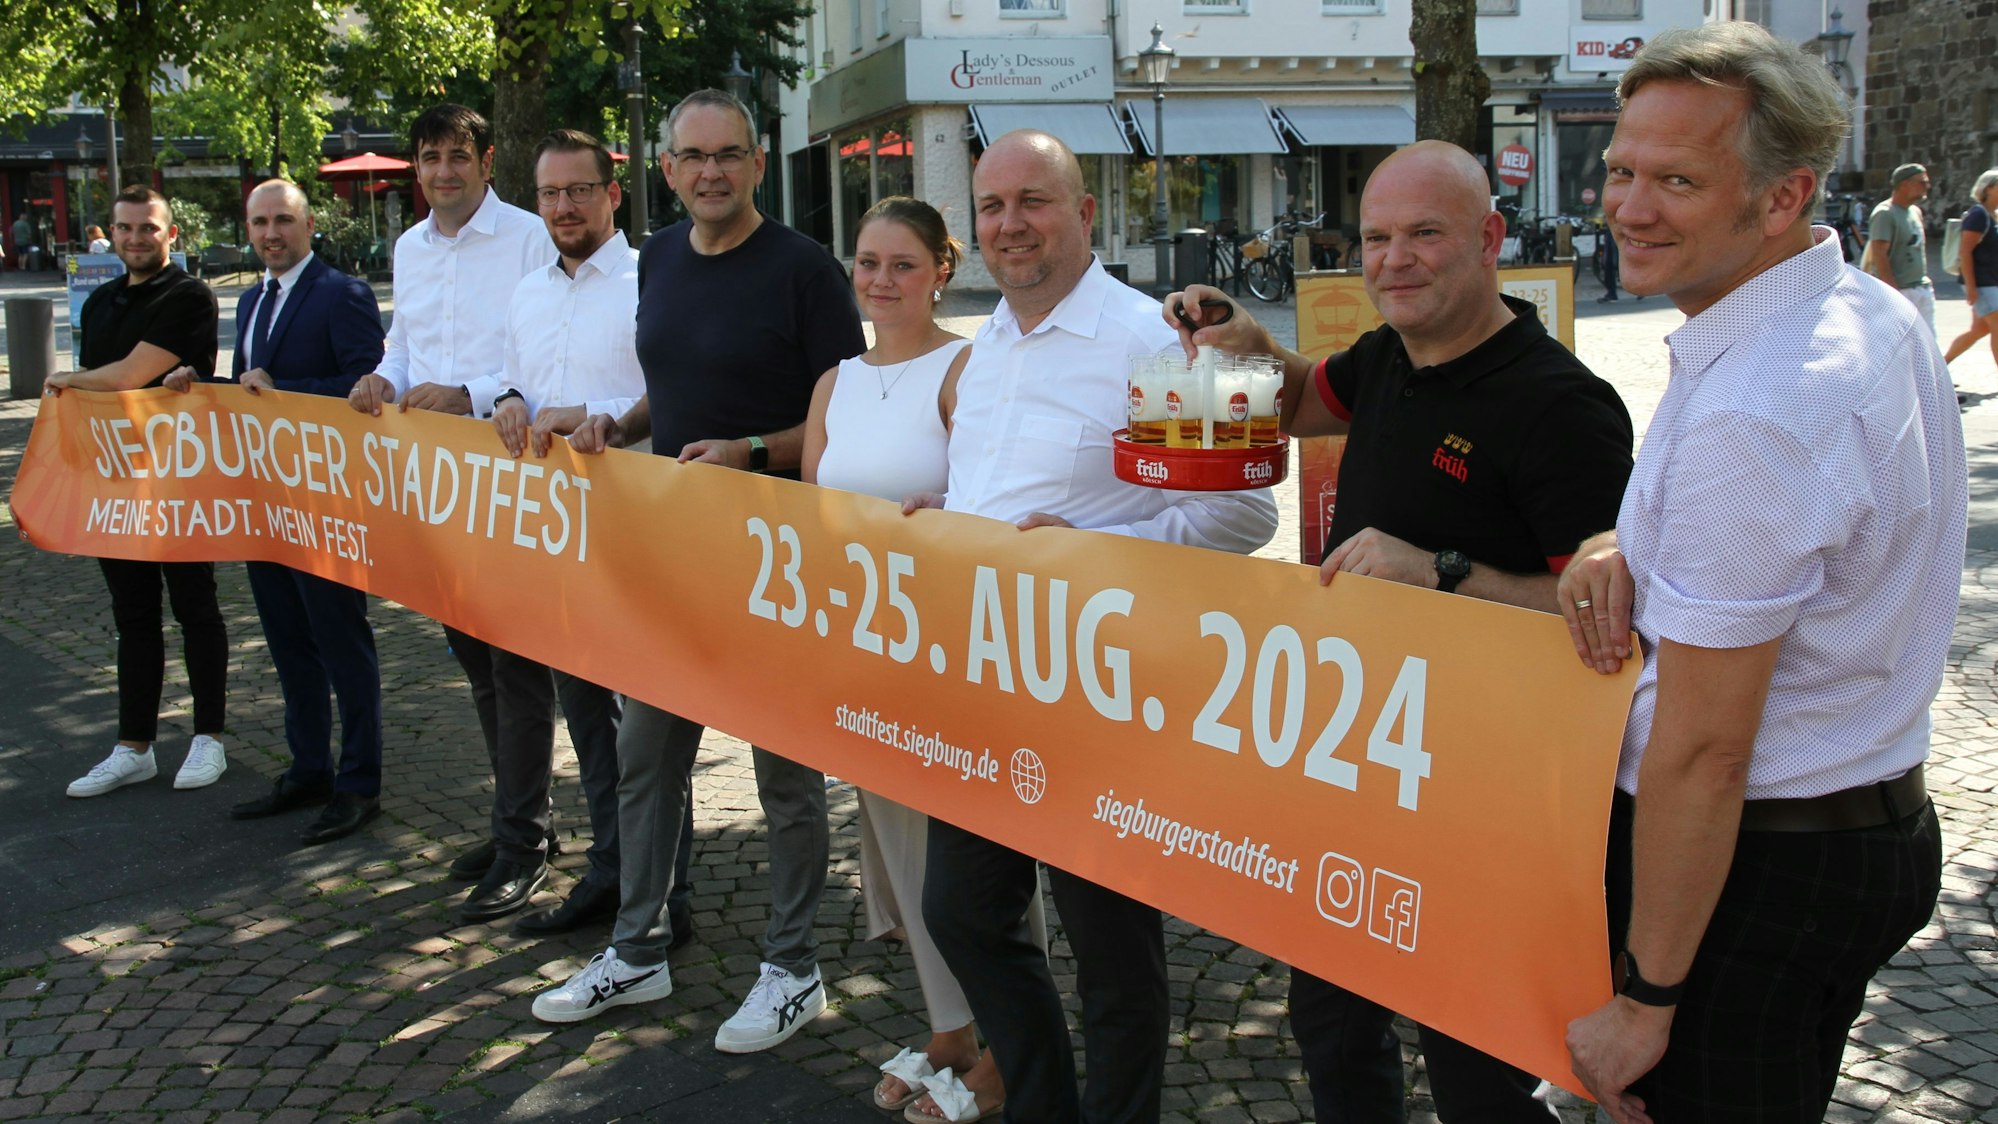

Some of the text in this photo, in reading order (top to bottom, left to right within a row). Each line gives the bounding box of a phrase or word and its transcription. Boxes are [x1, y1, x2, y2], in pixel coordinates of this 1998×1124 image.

[960, 50, 1075, 75] Lady's Dessous
[1576, 41, 1605, 56] KID
[950, 63, 1043, 89] Gentleman
[1051, 65, 1098, 93] OUTLET
[935, 134, 945, 143] 62
[1502, 151, 1529, 169] NEU
[89, 411, 592, 563] SIEGBURGER STADTFEST
[86, 497, 374, 567] MEINE STADT. MEIN FEST.
[746, 516, 1432, 812] 23.-25. AUG. 2024
[835, 703, 999, 783] stadtfest.siegburg.de
[1093, 789, 1299, 894] siegburgerstadtfest
